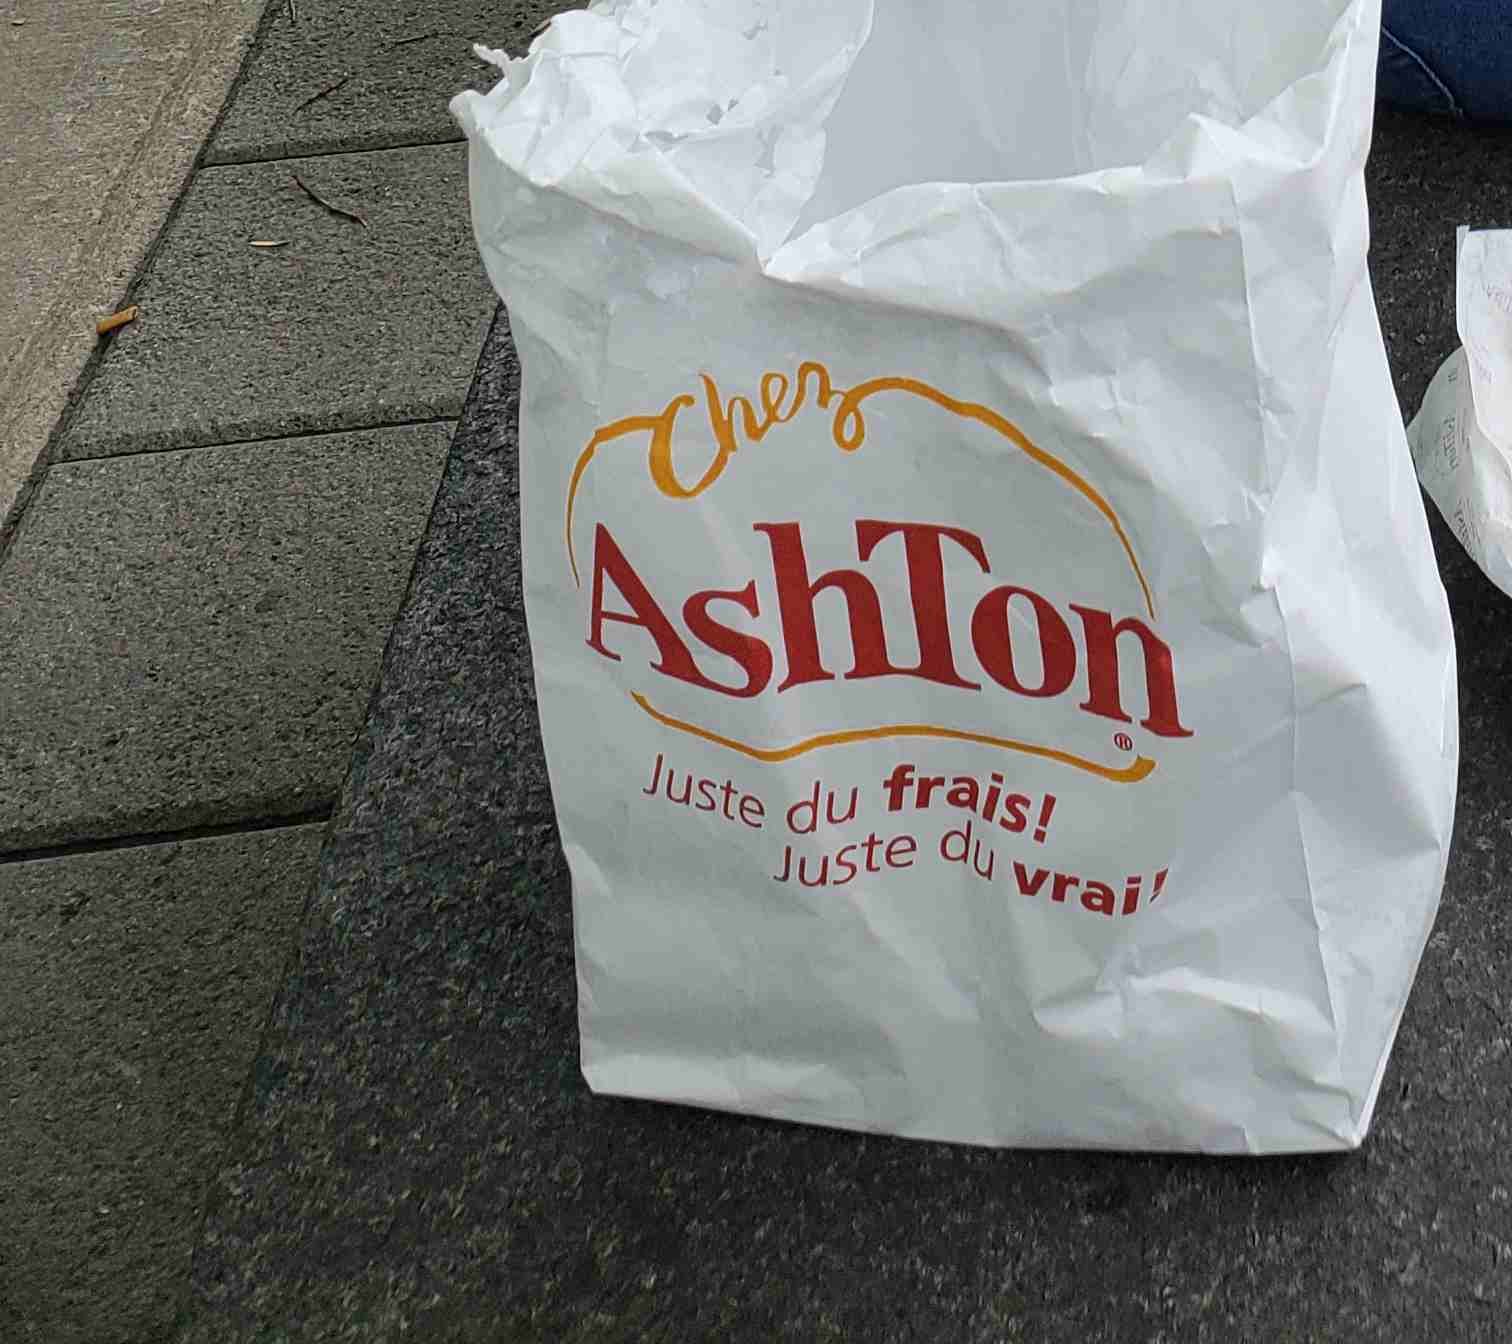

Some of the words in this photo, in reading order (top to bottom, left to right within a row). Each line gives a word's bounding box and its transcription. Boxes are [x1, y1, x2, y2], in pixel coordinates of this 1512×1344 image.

[650, 361, 864, 497] Chez
[585, 519, 1194, 737] AshTon
[643, 754, 764, 828] Juste
[786, 781, 858, 833] du
[882, 765, 1057, 843] frais!
[773, 832, 917, 887] Juste
[940, 820, 994, 880] du
[1012, 861, 1168, 916] vrai!
